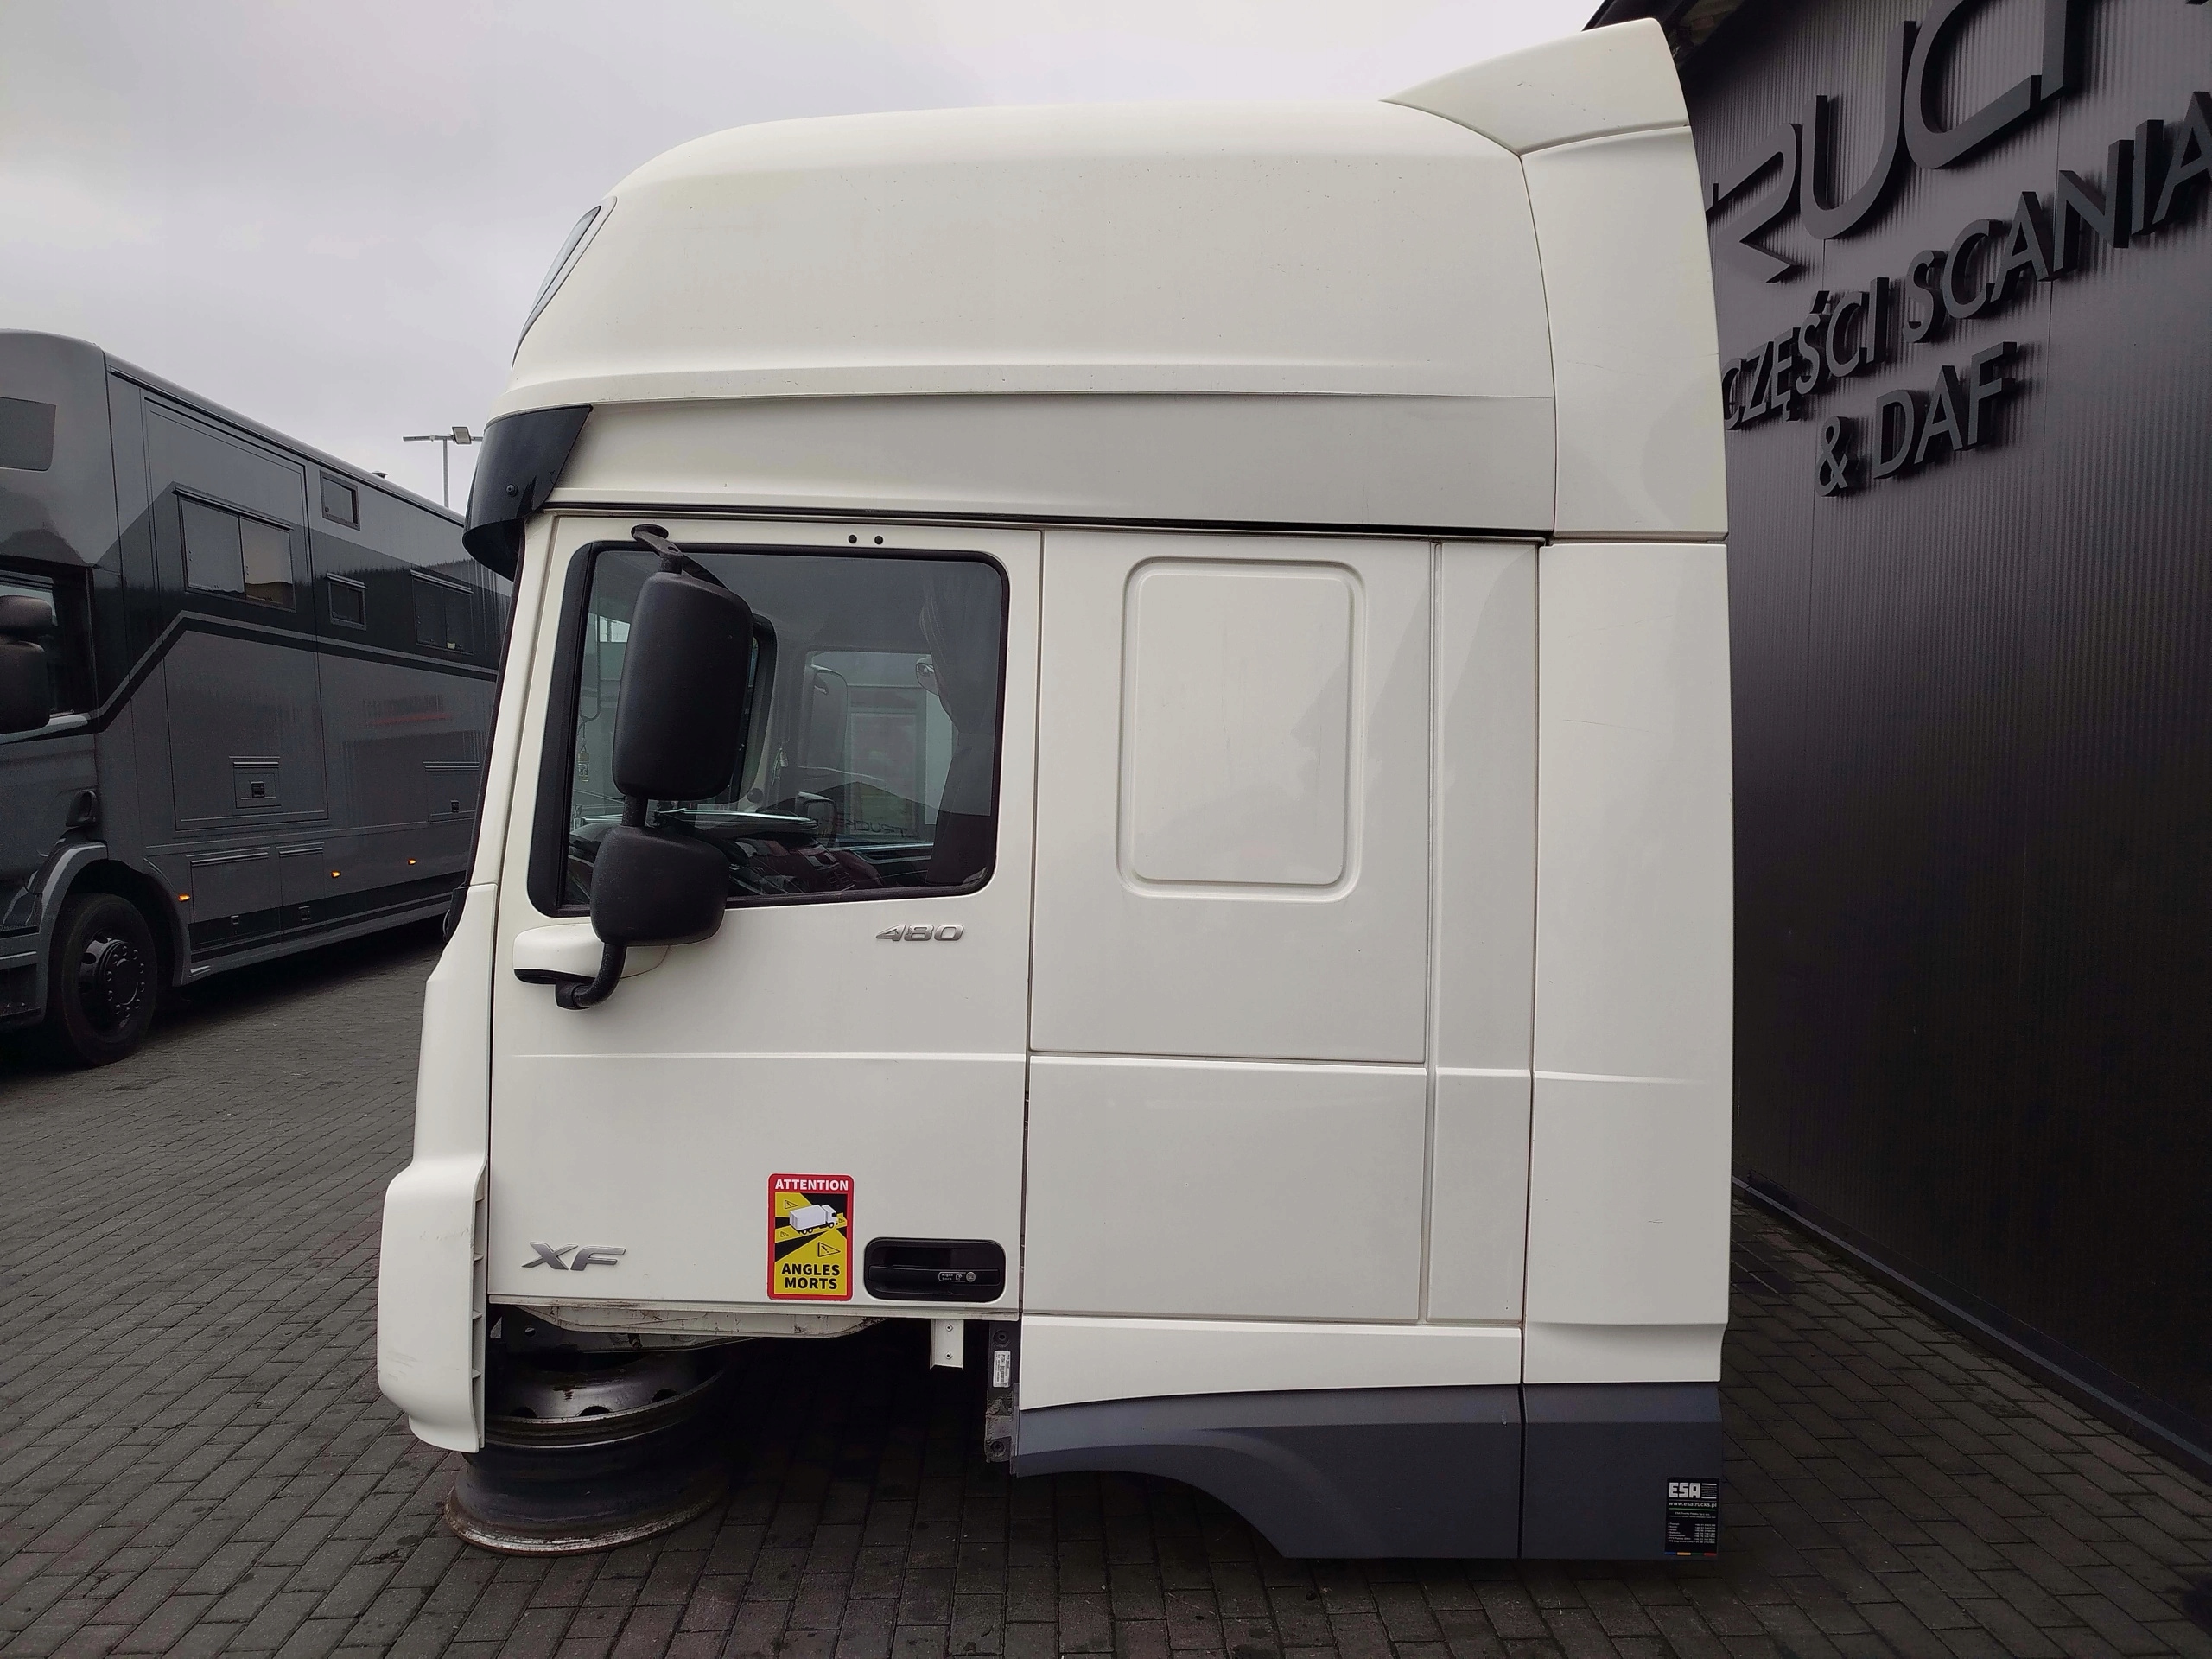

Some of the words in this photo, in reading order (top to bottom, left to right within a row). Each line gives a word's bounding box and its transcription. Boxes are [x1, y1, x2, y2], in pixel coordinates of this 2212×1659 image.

[1721, 276, 1889, 430] CZĘŚCI
[1903, 92, 2212, 343] SCANIA
[1815, 416, 1853, 497] &
[1873, 342, 2017, 480] DAF
[875, 924, 965, 942] 480
[774, 1179, 849, 1192] ATTENTION
[521, 1241, 626, 1272] XF
[781, 1262, 841, 1278] ANGLES
[784, 1276, 838, 1291] MORTS
[1669, 1482, 1700, 1498] ESA
